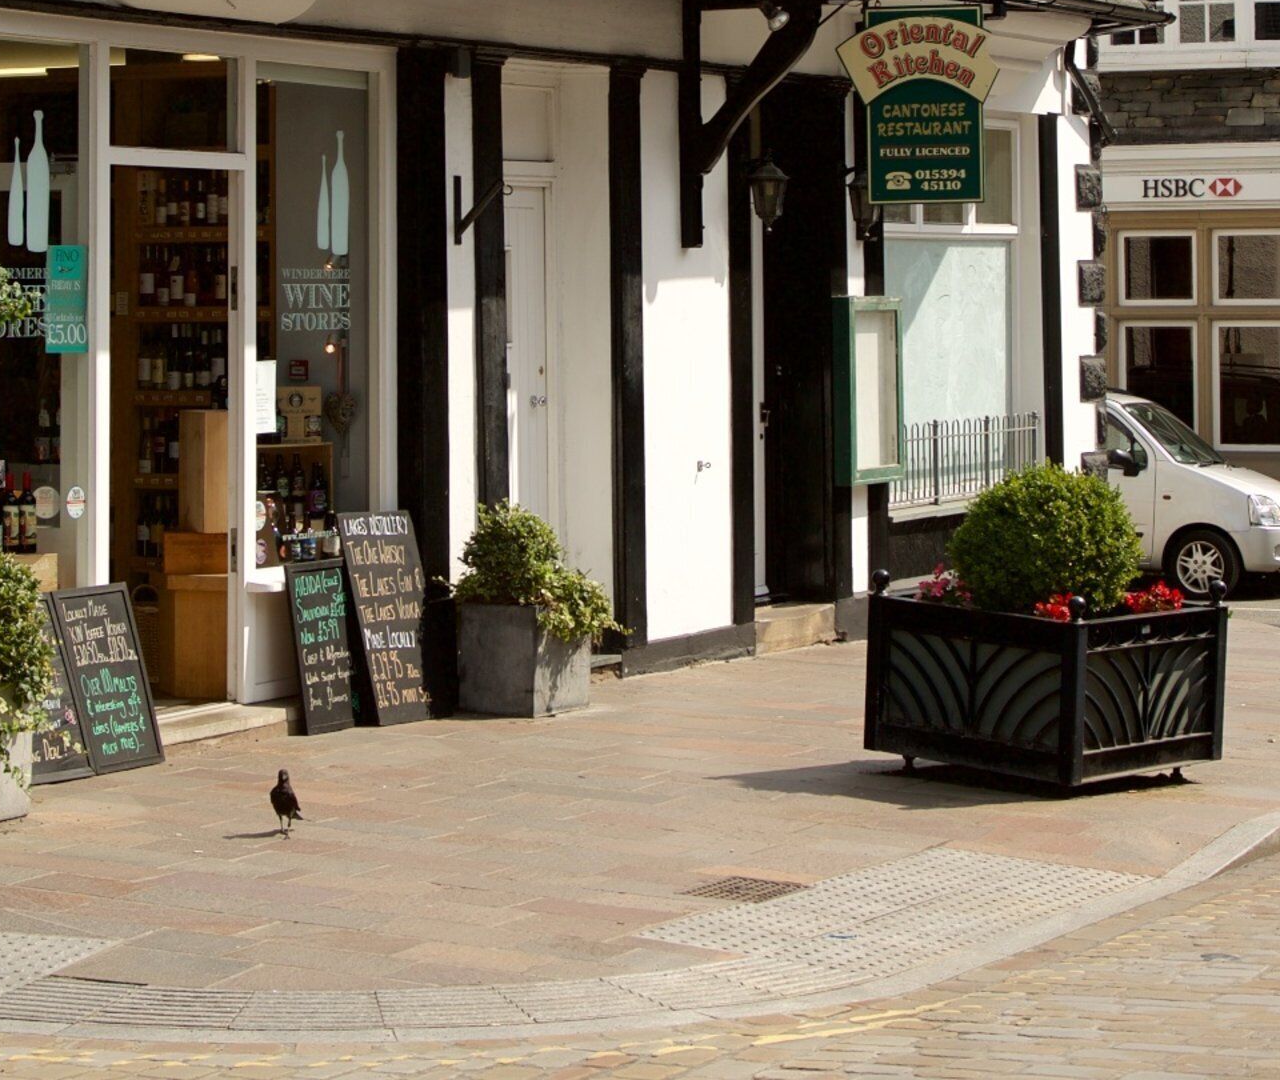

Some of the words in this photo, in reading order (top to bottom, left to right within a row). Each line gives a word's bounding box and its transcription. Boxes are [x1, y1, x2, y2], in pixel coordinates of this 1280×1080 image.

[859, 22, 986, 60] Oriental
[867, 49, 976, 90] Kitchen
[882, 102, 966, 118] CANTONESE
[877, 121, 972, 137] RESTAURANT
[880, 147, 913, 157] FULLY
[915, 146, 970, 157] LICENCED
[914, 169, 966, 180] 015394
[921, 181, 962, 191] 45110
[1142, 178, 1205, 198] HSBC
[282, 269, 350, 279] WINDERMERE
[281, 284, 350, 308] WINE
[281, 312, 351, 332] STORES
[47, 323, 87, 344] £5.00
[344, 518, 367, 536] LAKES
[369, 515, 408, 535] DISTILLERY
[346, 541, 363, 566] THE
[378, 540, 405, 566] WHISKY
[354, 574, 370, 598] THE
[370, 573, 397, 596] LAKES
[88, 599, 109, 617] MADE
[359, 606, 375, 624] THE
[374, 602, 396, 621] LAKES
[396, 597, 420, 620] VODKA
[364, 628, 385, 650] MADE
[386, 626, 416, 649] LOCALLY
